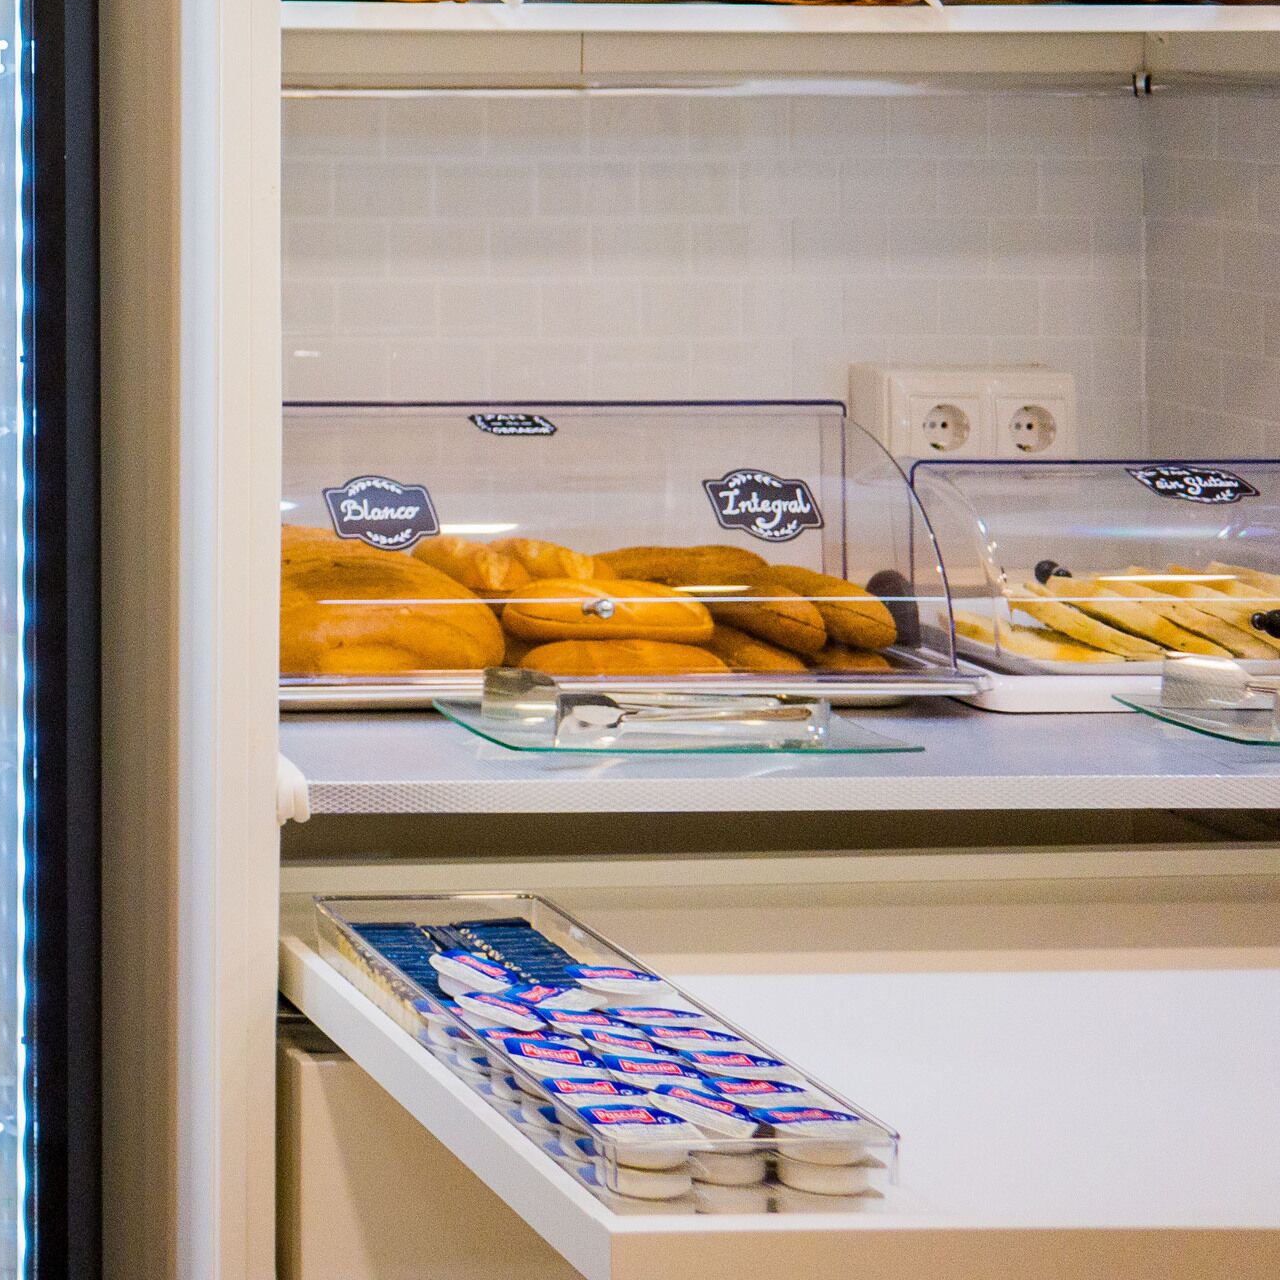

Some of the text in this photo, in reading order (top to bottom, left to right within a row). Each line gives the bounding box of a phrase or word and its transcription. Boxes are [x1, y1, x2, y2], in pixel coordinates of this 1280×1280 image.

[340, 498, 420, 523] Blanco
[718, 487, 811, 530] Integral
[523, 1043, 581, 1064] Pascual
[619, 1059, 683, 1075] Pascual
[593, 1109, 655, 1123] Pascual
